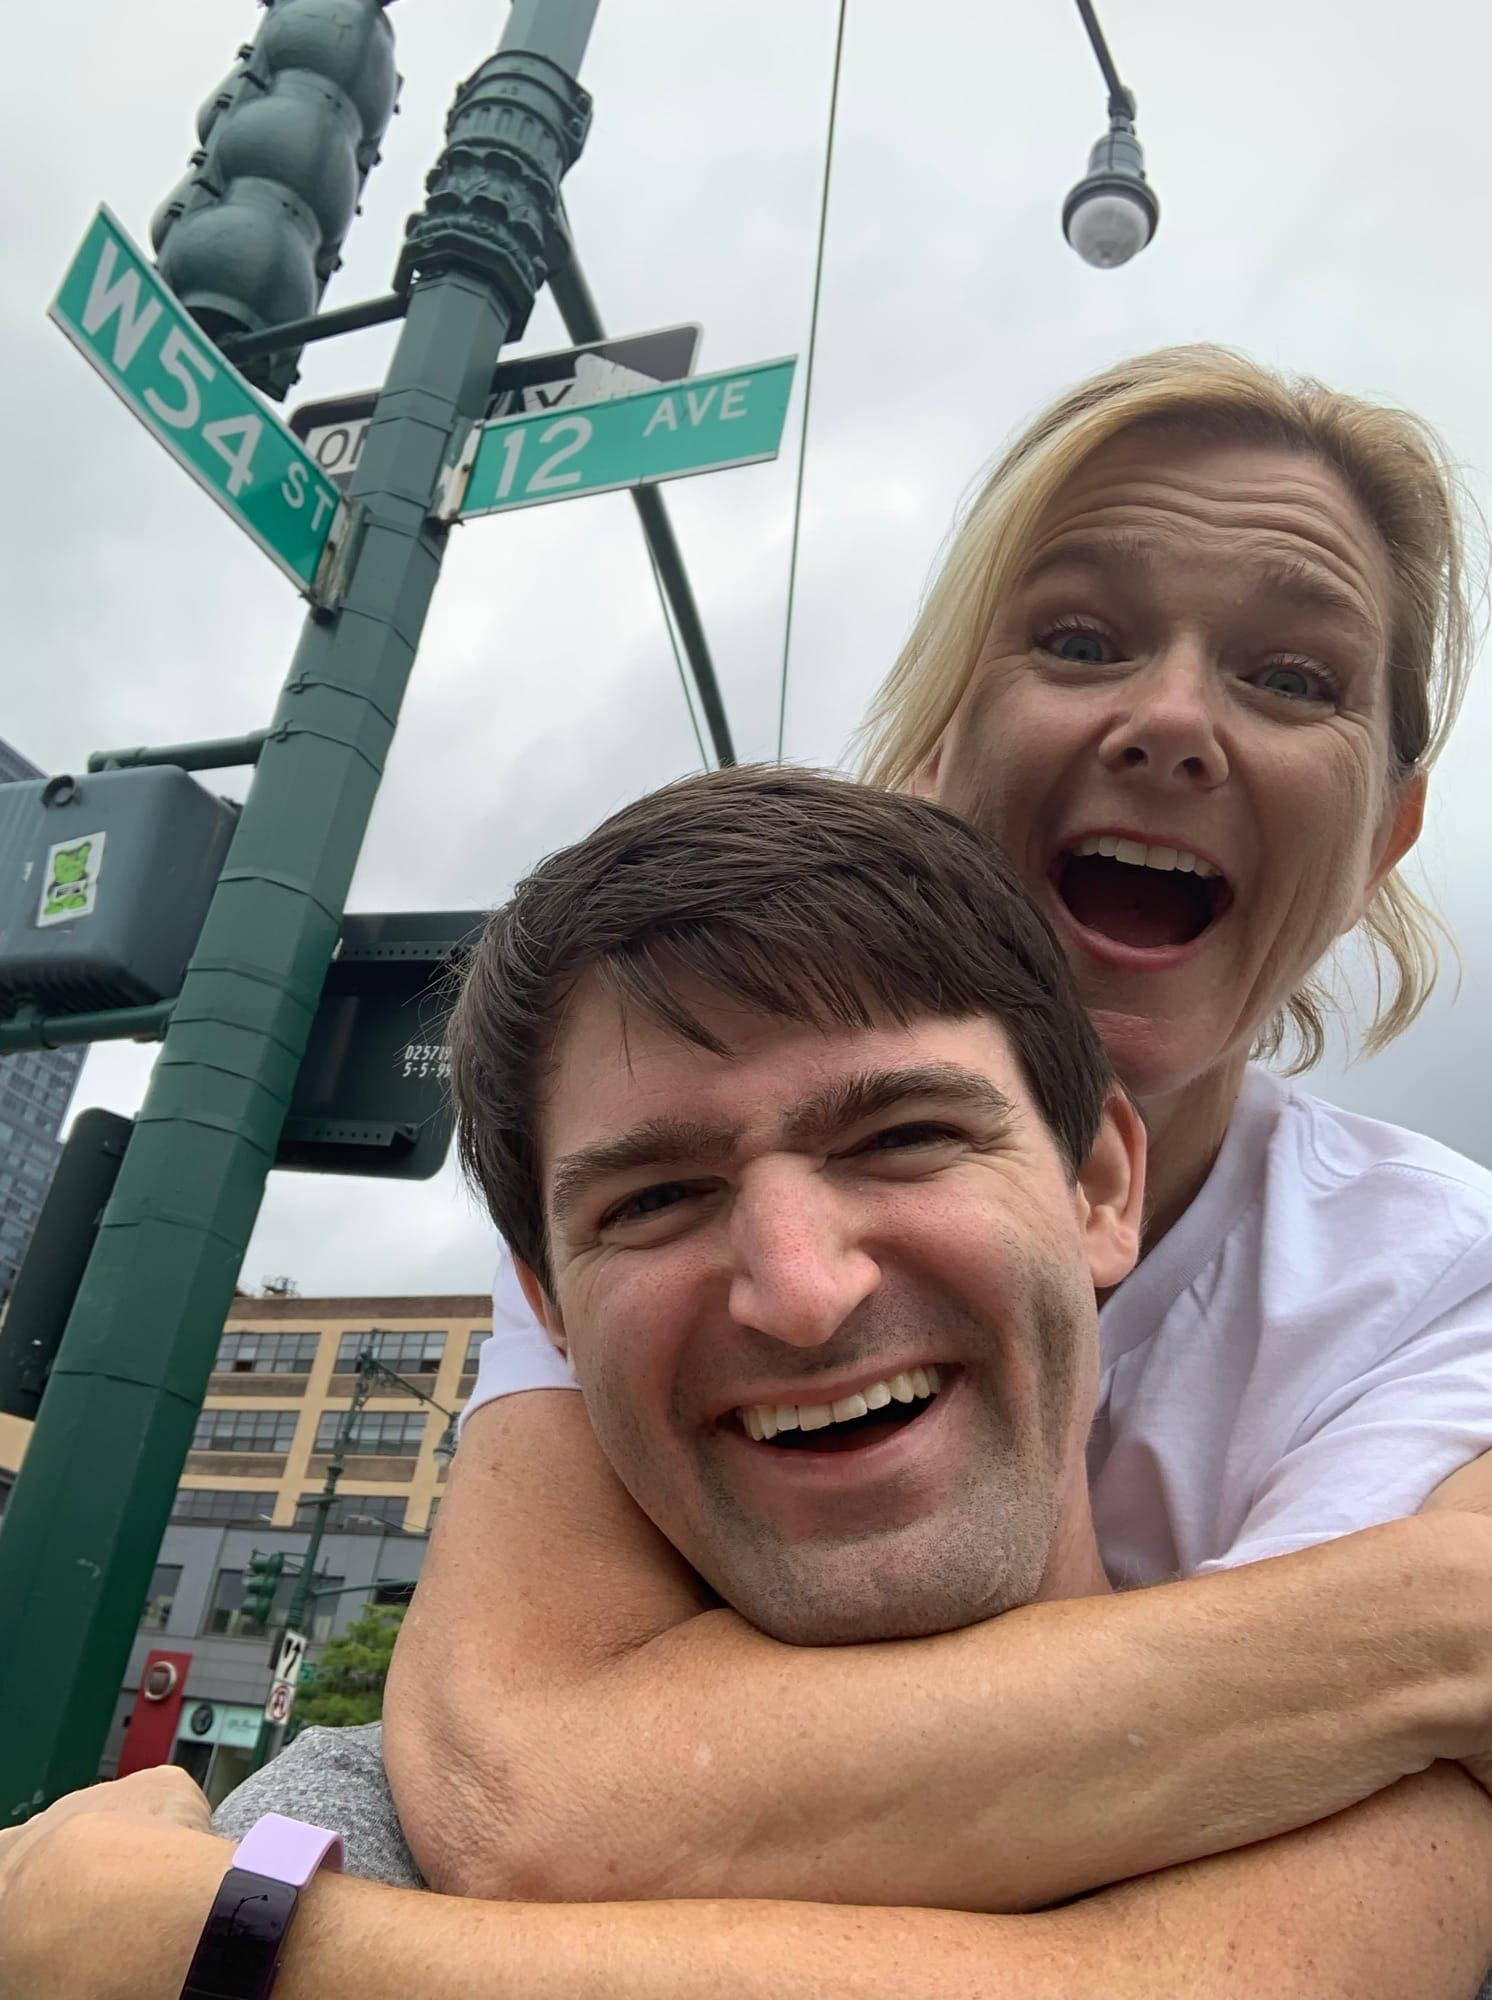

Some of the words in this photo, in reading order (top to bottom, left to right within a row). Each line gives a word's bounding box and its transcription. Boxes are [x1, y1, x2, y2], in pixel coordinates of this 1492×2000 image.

[495, 415, 593, 500] 12
[642, 378, 752, 438] AVE
[281, 460, 335, 532] ST
